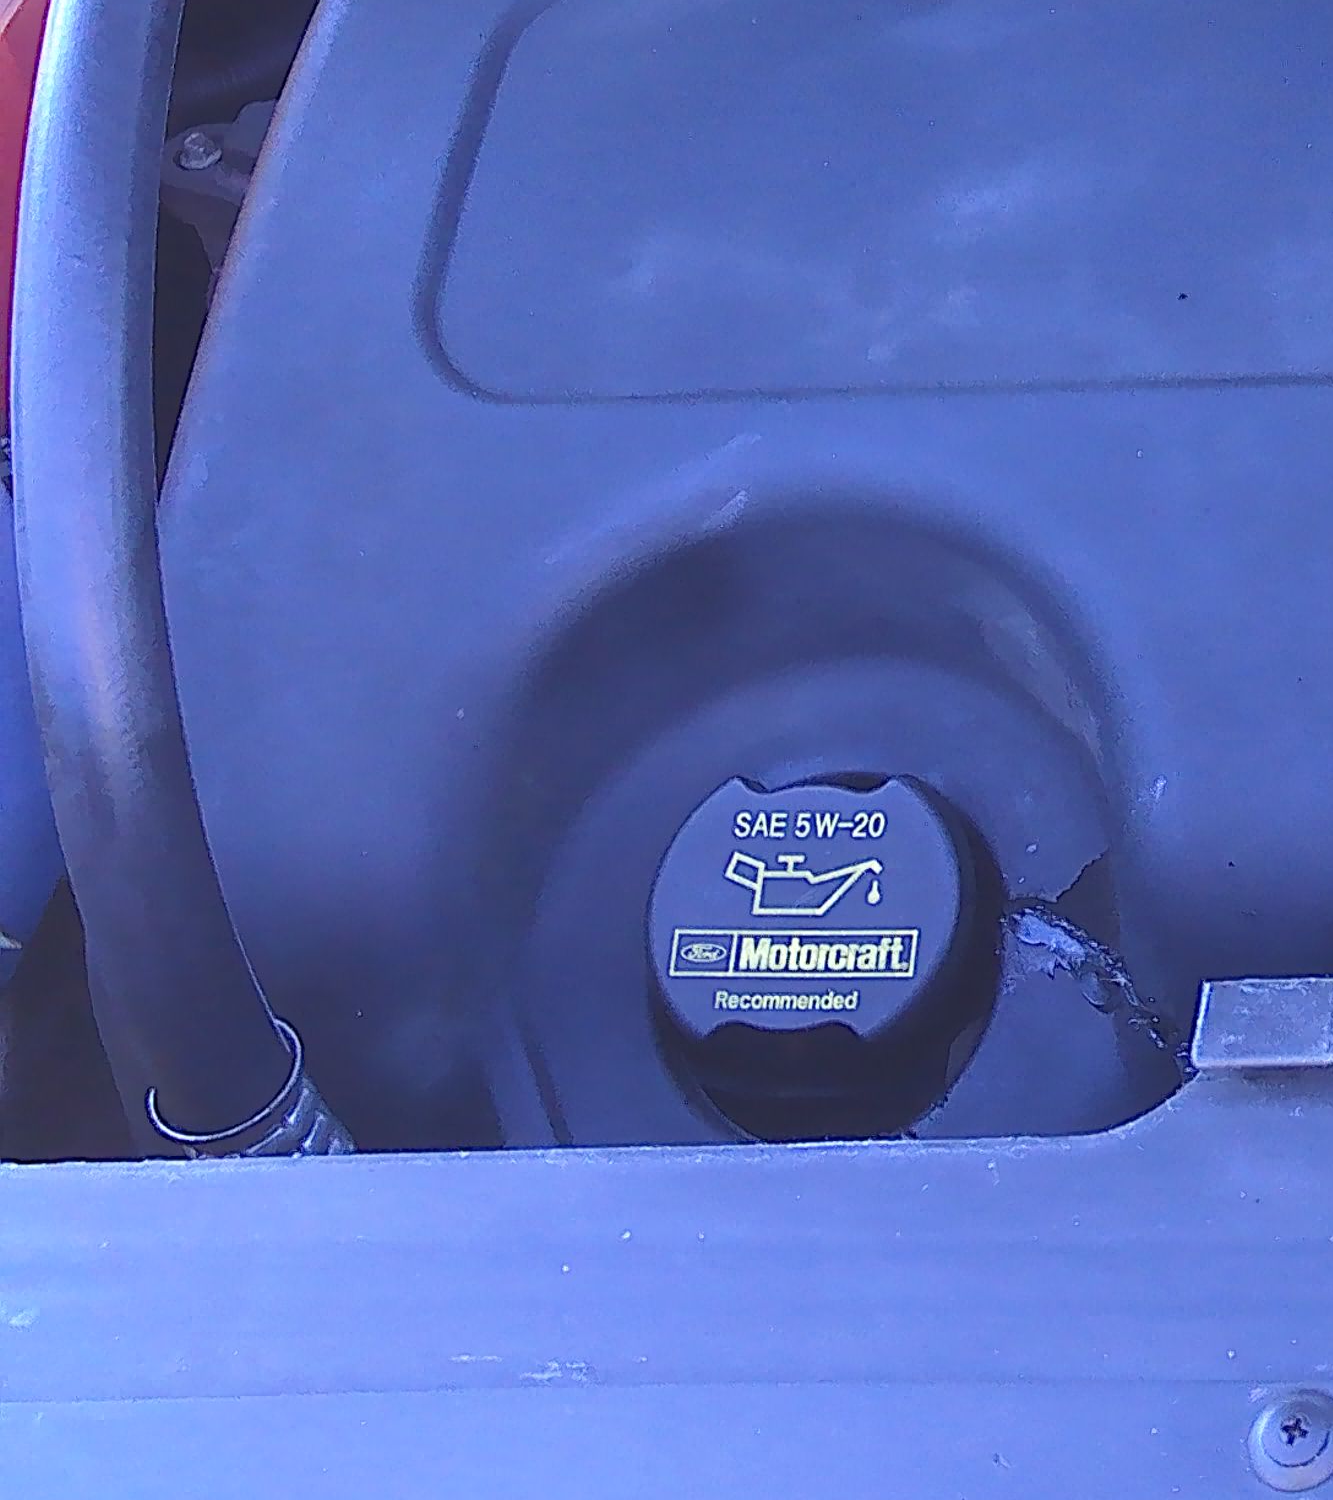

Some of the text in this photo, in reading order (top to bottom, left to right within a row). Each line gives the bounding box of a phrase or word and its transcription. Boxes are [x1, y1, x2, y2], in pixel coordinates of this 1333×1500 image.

[734, 812, 886, 837] SAE 5W-20
[739, 937, 903, 970] Motorcraft
[714, 989, 858, 1010] Recommended
